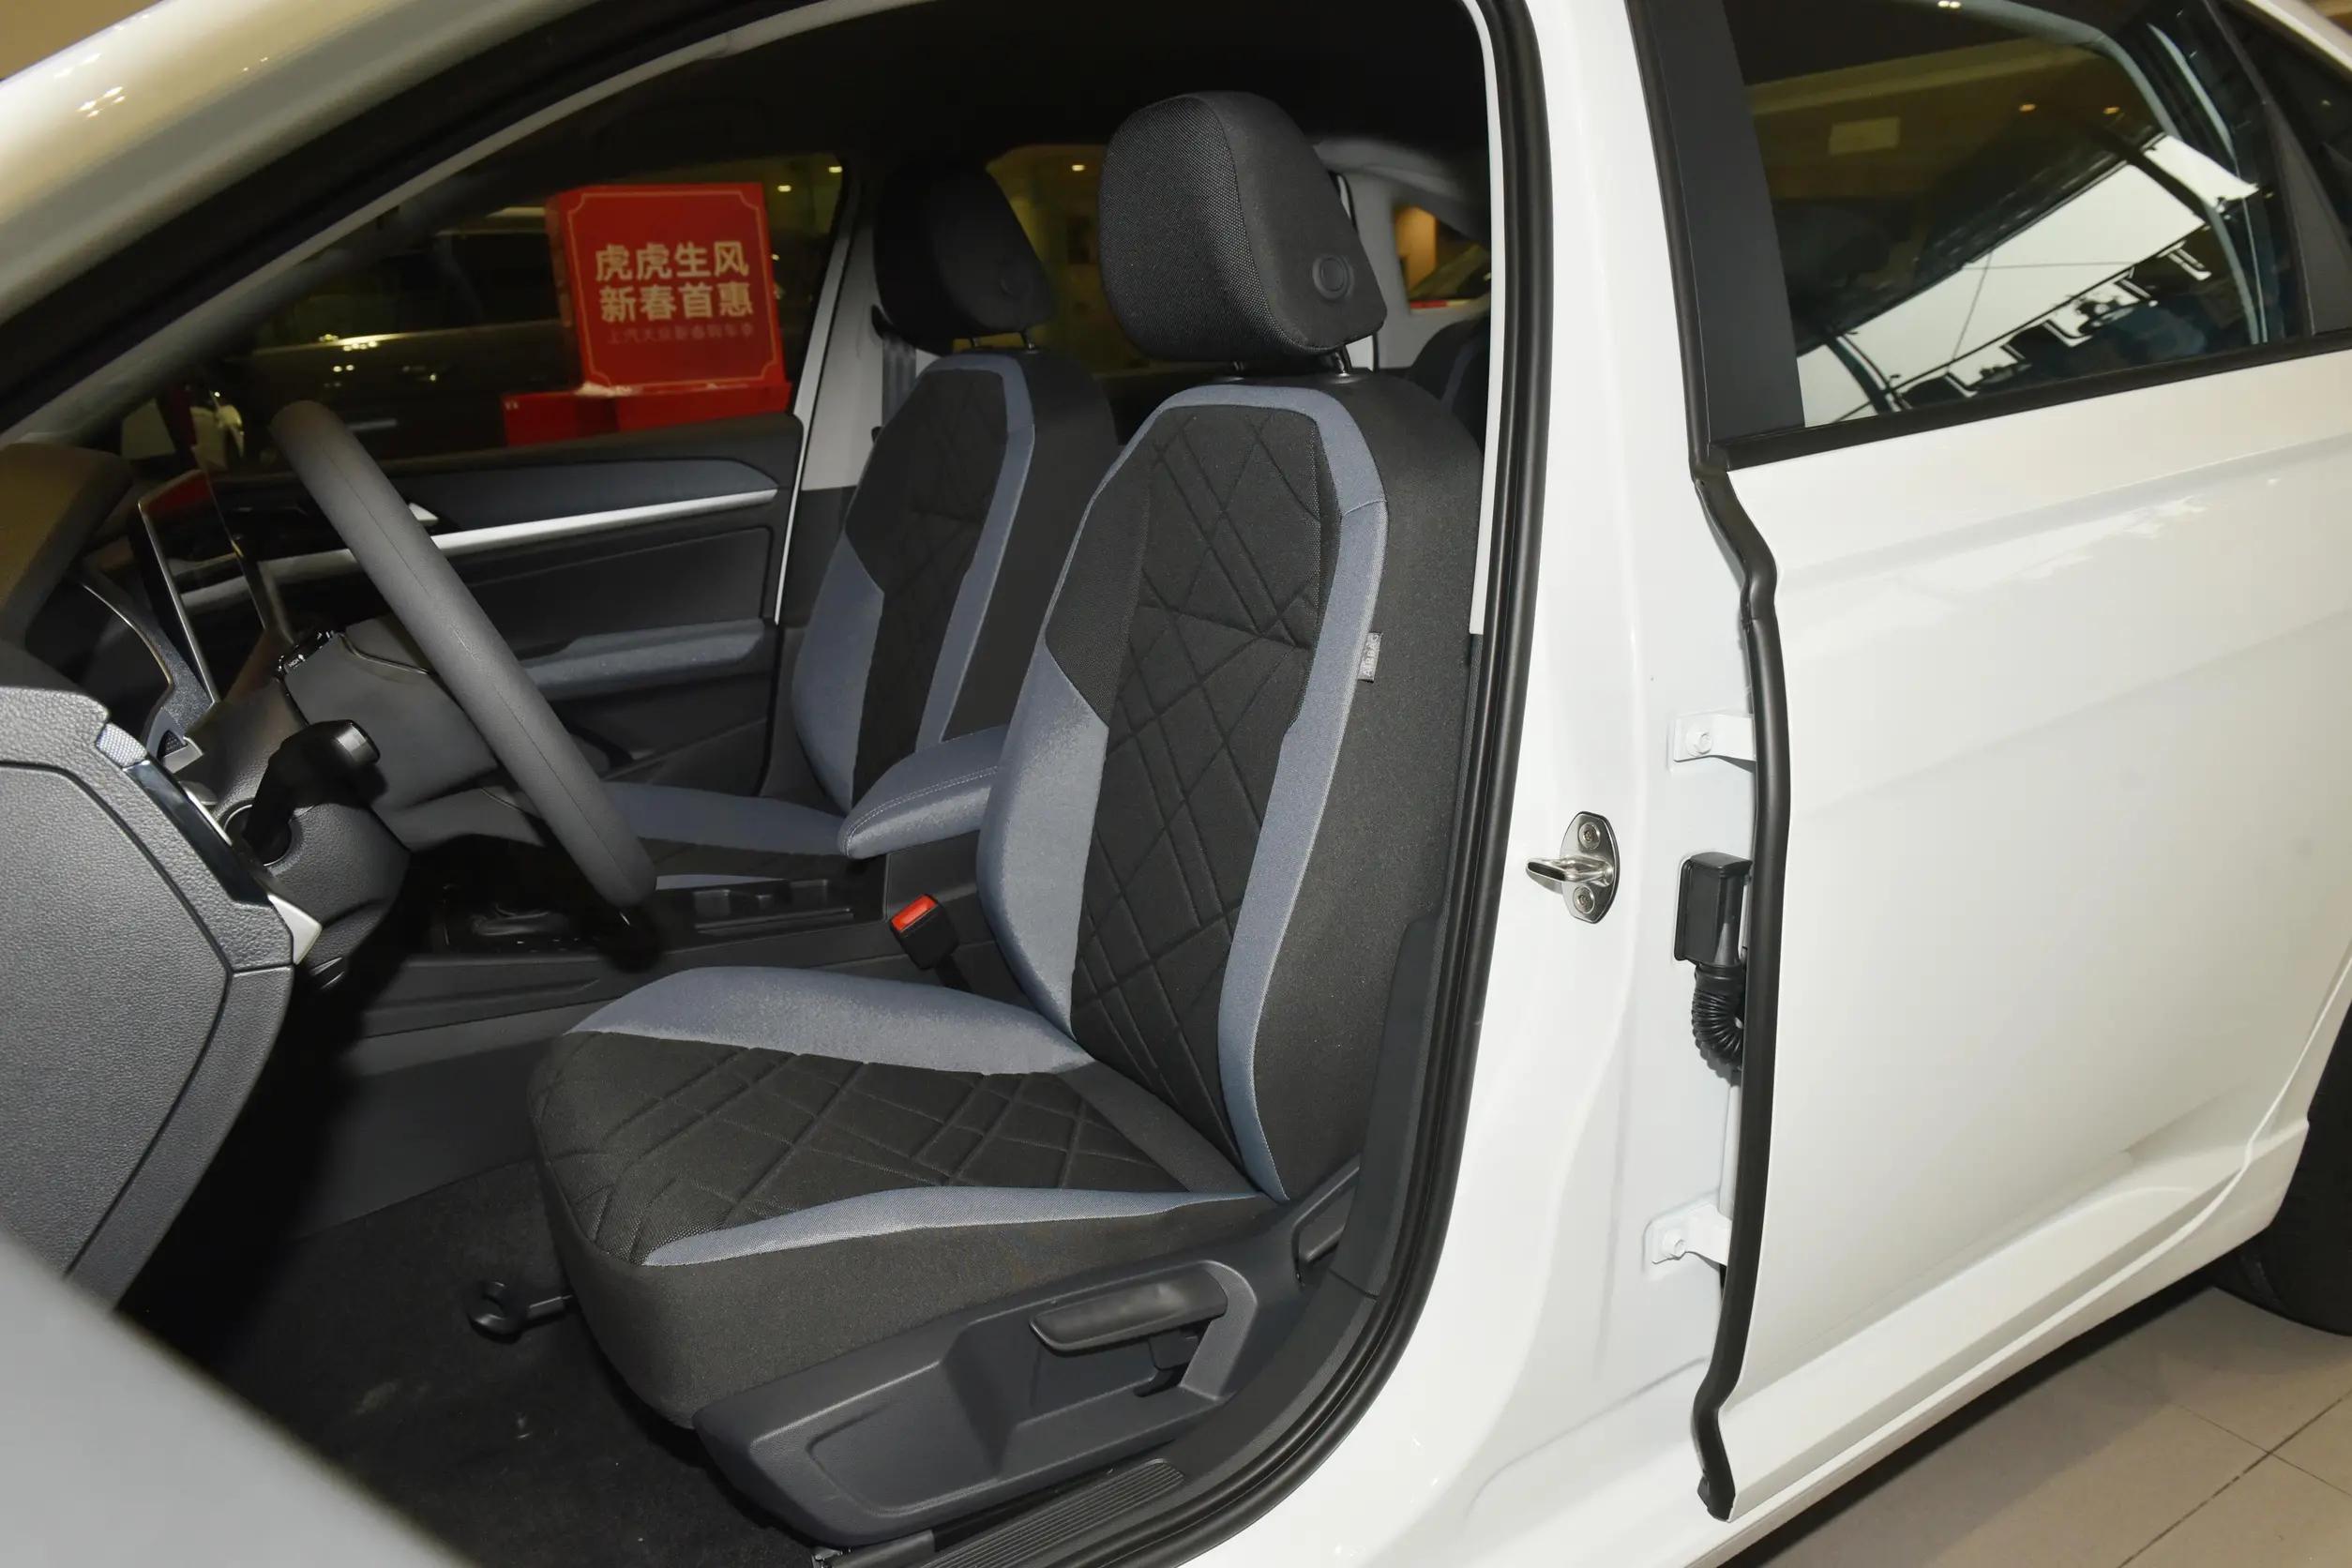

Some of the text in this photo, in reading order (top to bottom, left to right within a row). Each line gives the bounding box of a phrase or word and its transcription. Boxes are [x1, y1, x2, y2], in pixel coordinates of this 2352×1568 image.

[596, 241, 748, 280] 虎虎生风
[599, 281, 753, 322] 新春首惠
